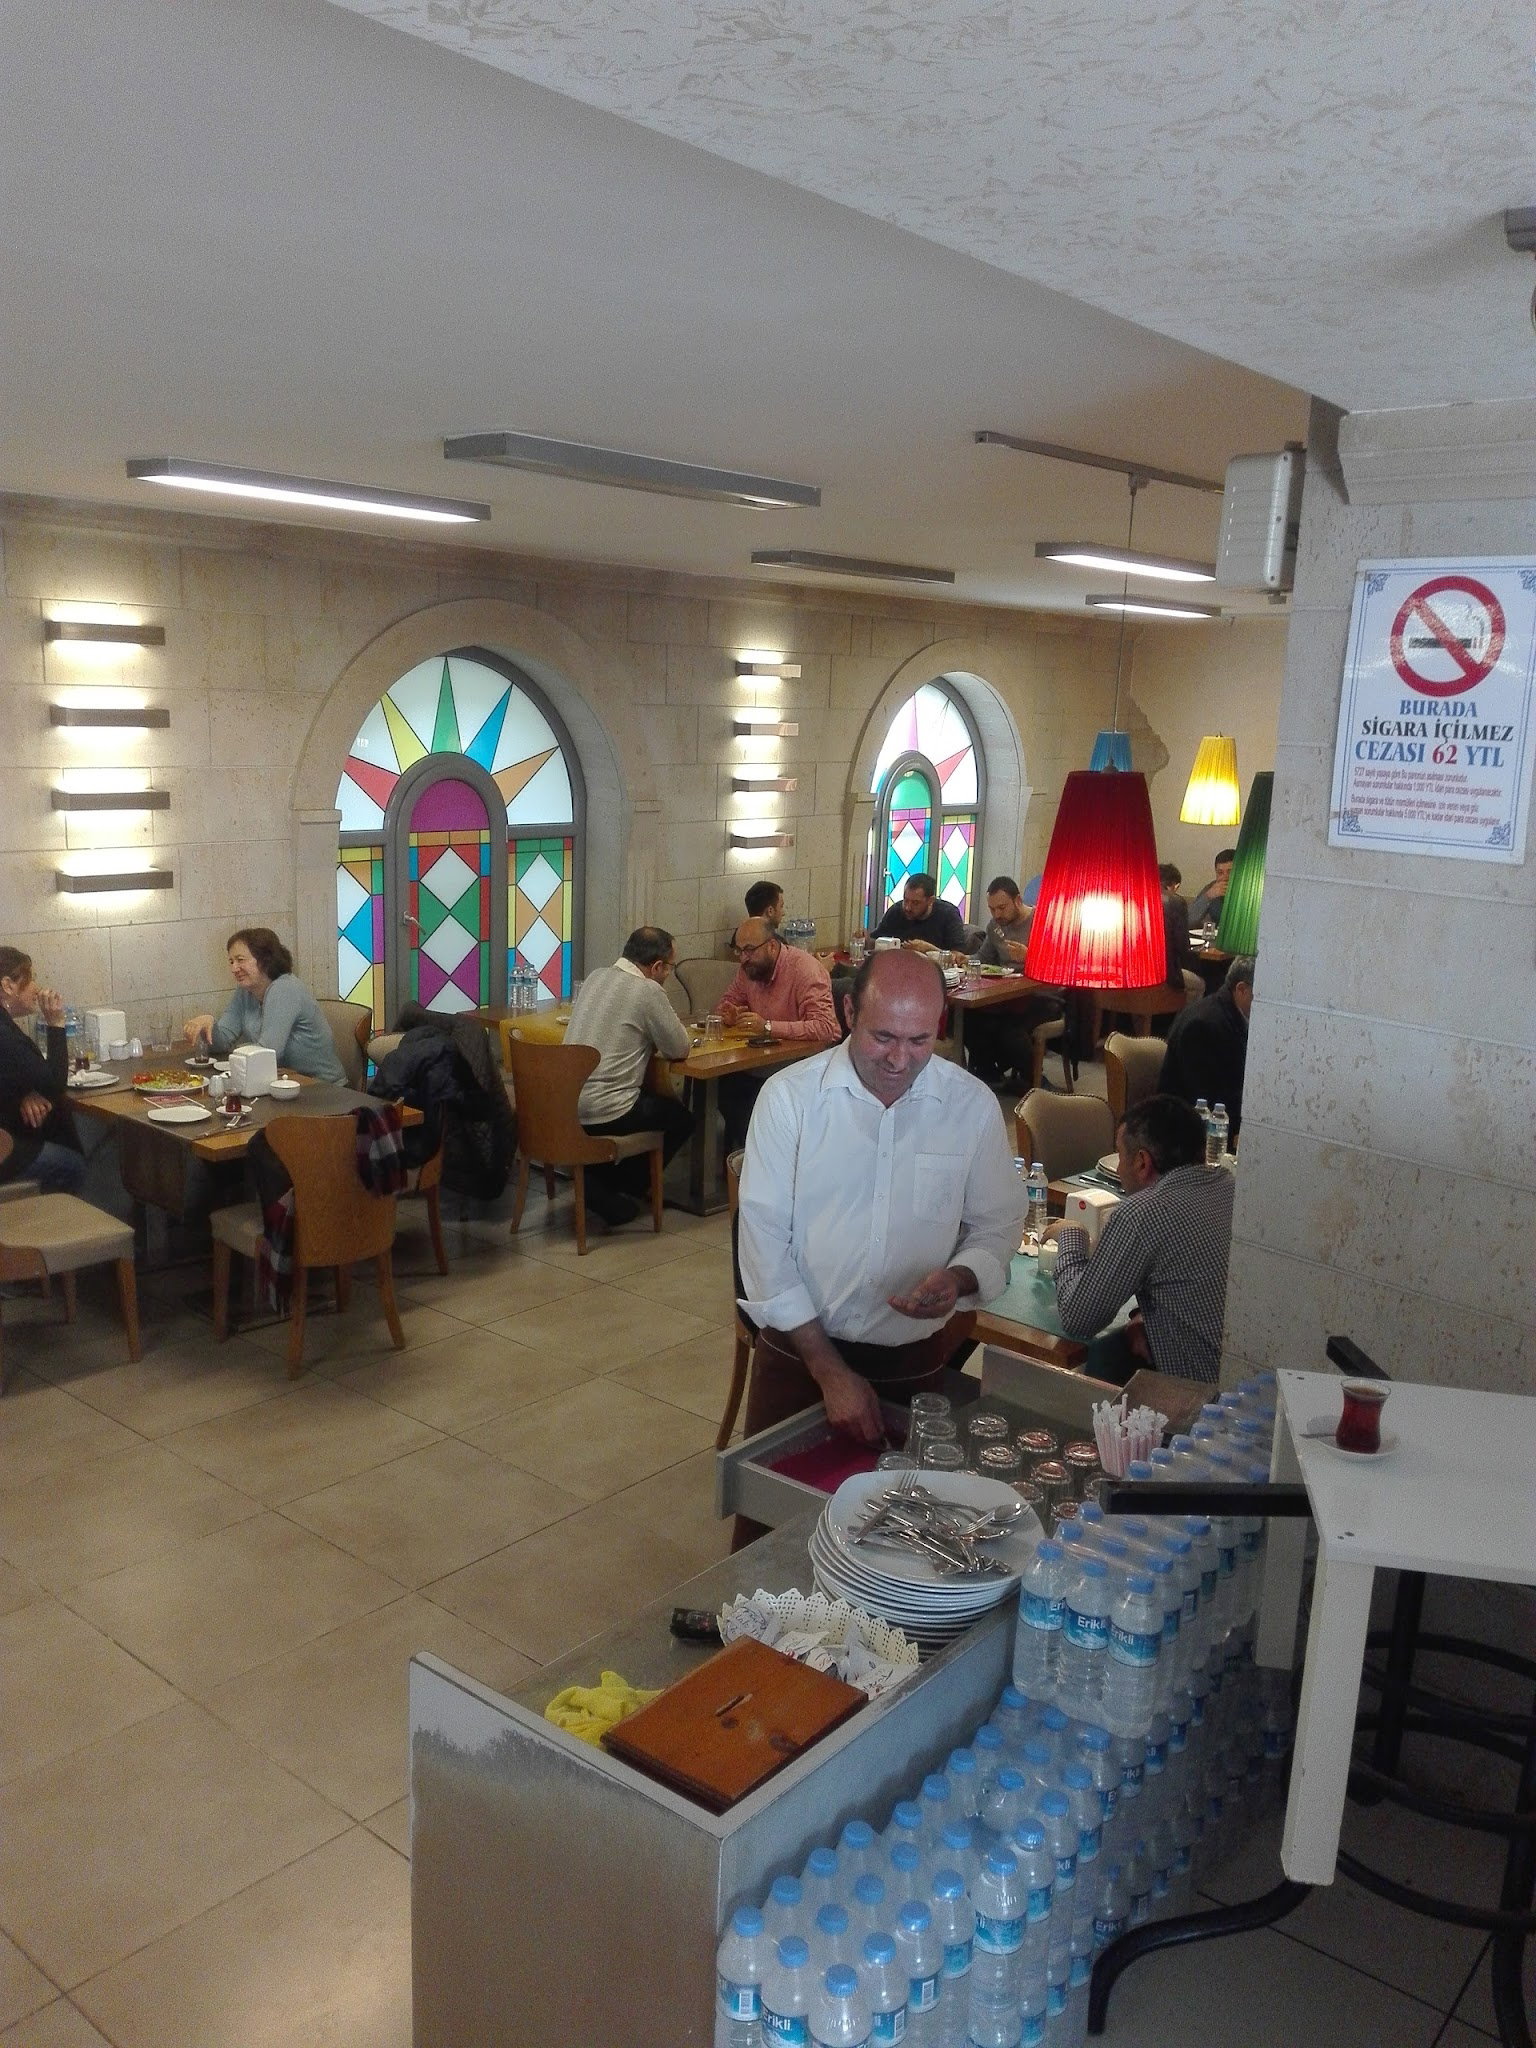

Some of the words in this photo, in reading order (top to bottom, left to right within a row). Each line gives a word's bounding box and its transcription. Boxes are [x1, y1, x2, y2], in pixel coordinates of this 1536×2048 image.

[1400, 700, 1478, 718] BURADA
[1361, 716, 1428, 738] SİGARA
[1433, 718, 1515, 744] İÇİLMEZ
[1355, 740, 1426, 763] CEZASI
[1432, 744, 1458, 765] 62
[1465, 745, 1505, 768] YTL
